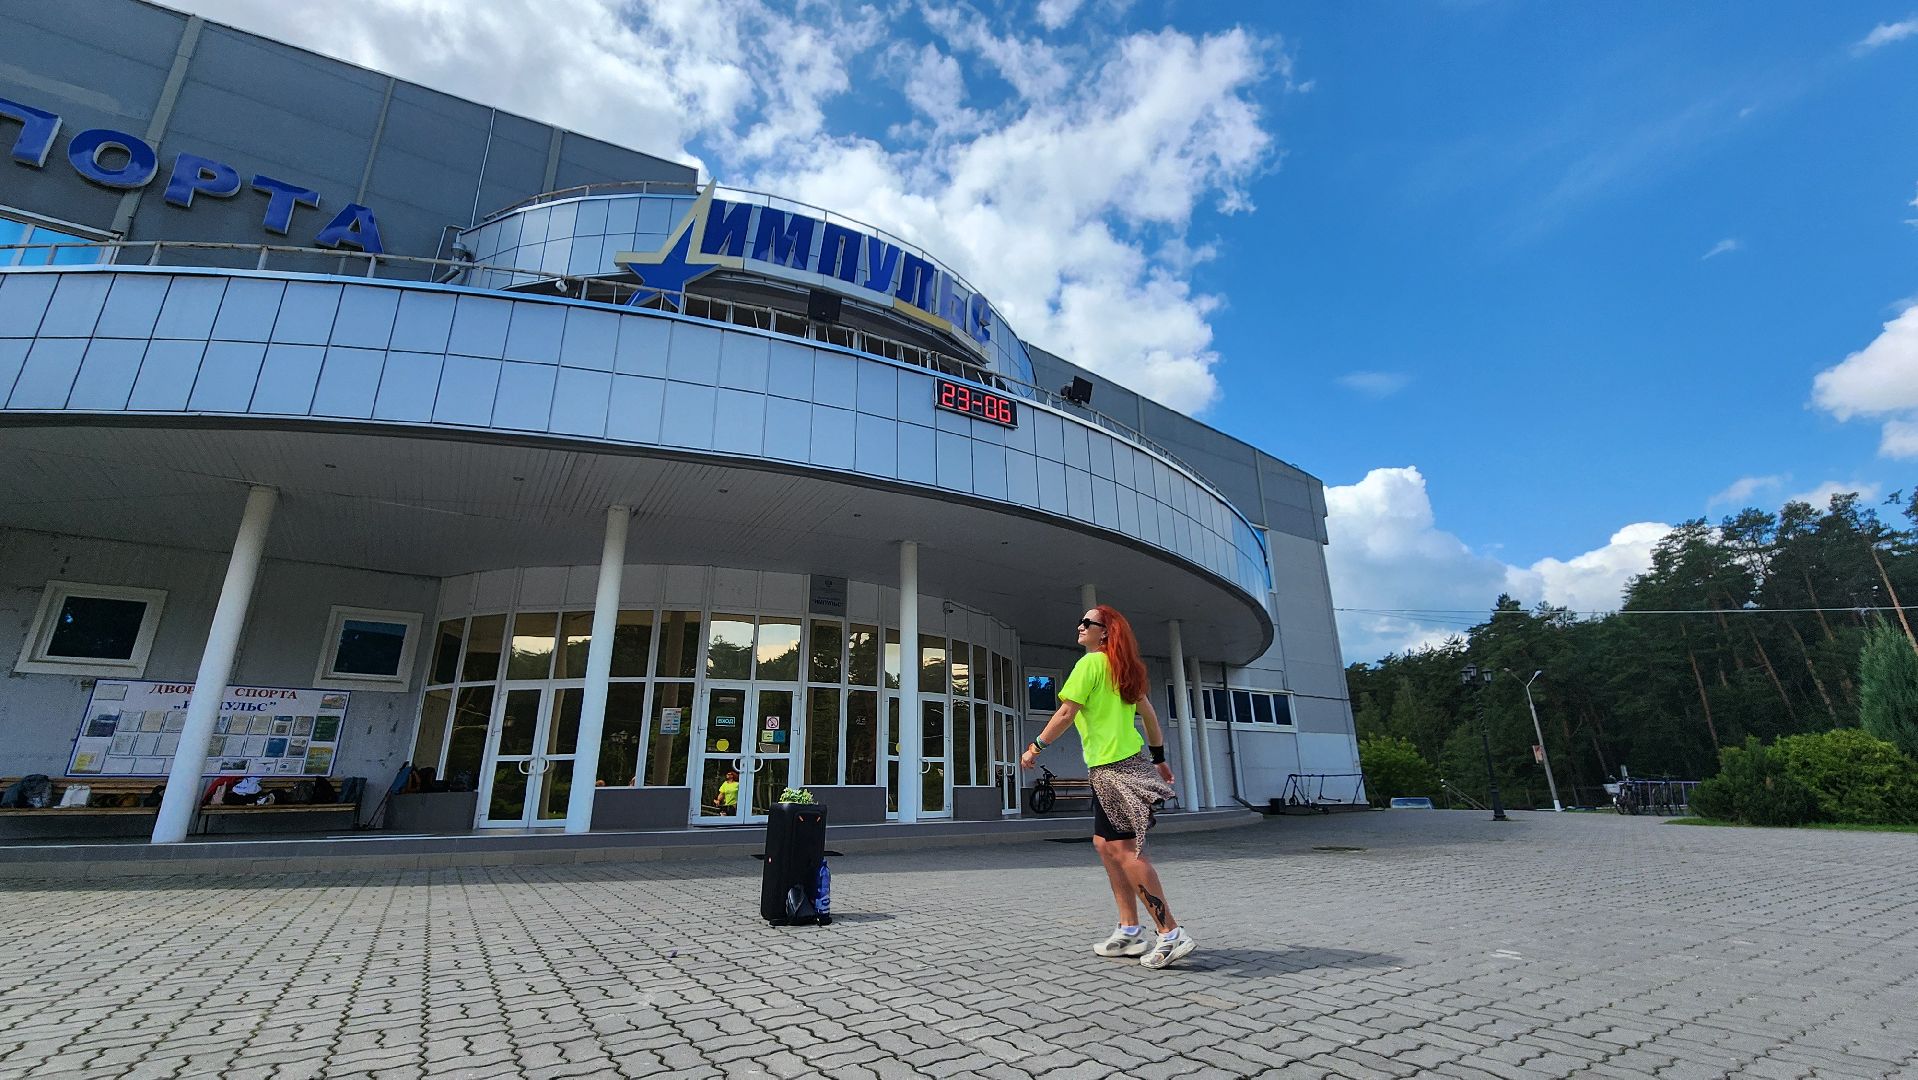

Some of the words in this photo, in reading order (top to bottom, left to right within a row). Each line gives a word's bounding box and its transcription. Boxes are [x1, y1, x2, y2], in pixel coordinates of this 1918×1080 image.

[700, 197, 992, 343] ИМПУЛЬС
[942, 383, 1011, 422] 23-06
[149, 684, 195, 695] ДВОР
[235, 687, 299, 700] СПОРТА
